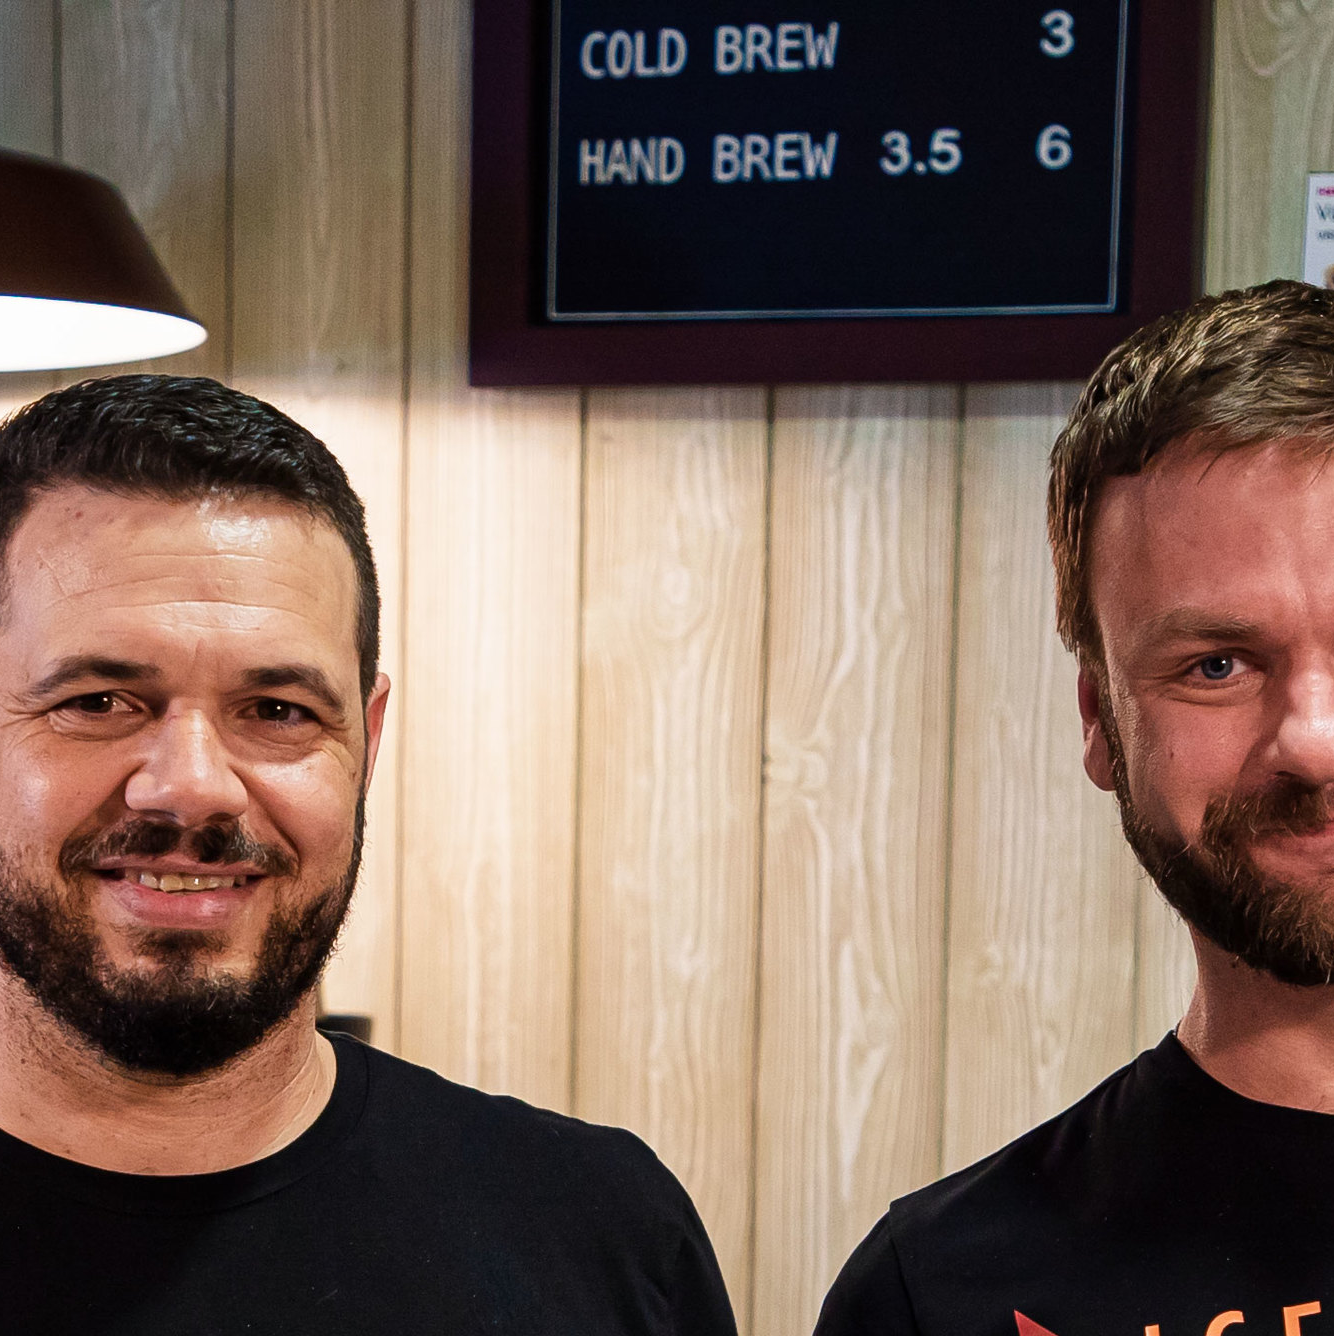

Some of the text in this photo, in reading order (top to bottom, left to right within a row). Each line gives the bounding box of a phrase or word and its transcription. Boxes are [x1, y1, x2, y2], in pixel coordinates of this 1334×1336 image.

[581, 9, 1075, 80] COLD BREW 3
[579, 124, 1072, 186] HAND BREW 3.5 6
